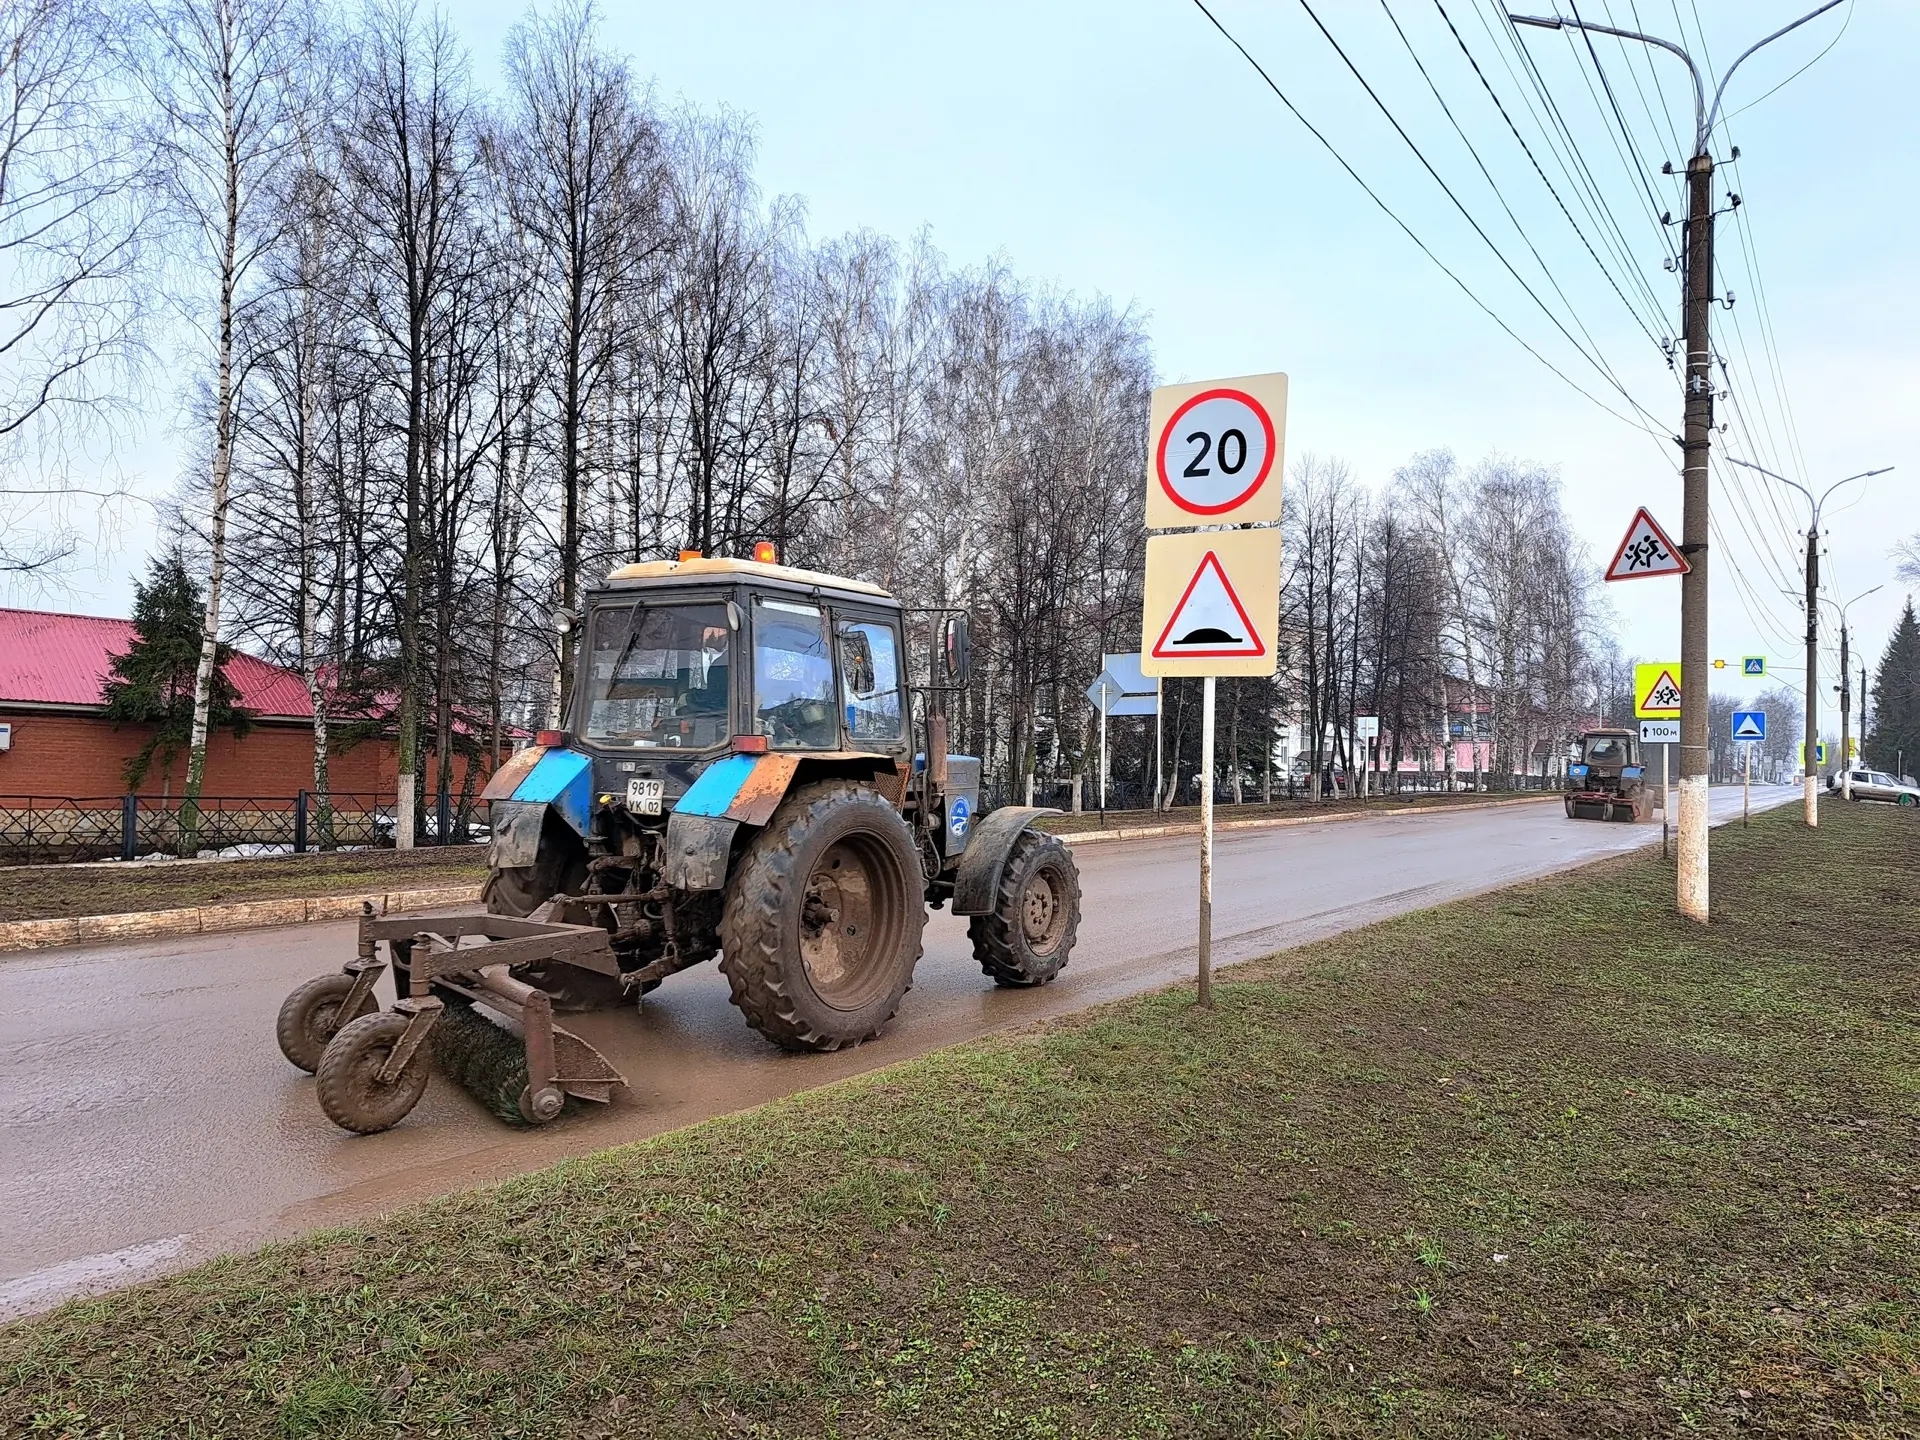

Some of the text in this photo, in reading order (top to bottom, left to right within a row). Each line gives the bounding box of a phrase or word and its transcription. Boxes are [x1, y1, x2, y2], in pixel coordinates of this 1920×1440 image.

[1183, 428, 1247, 478] 20
[1652, 727, 1669, 736] 100
[631, 781, 659, 797] 9819
[647, 801, 659, 813] 02
